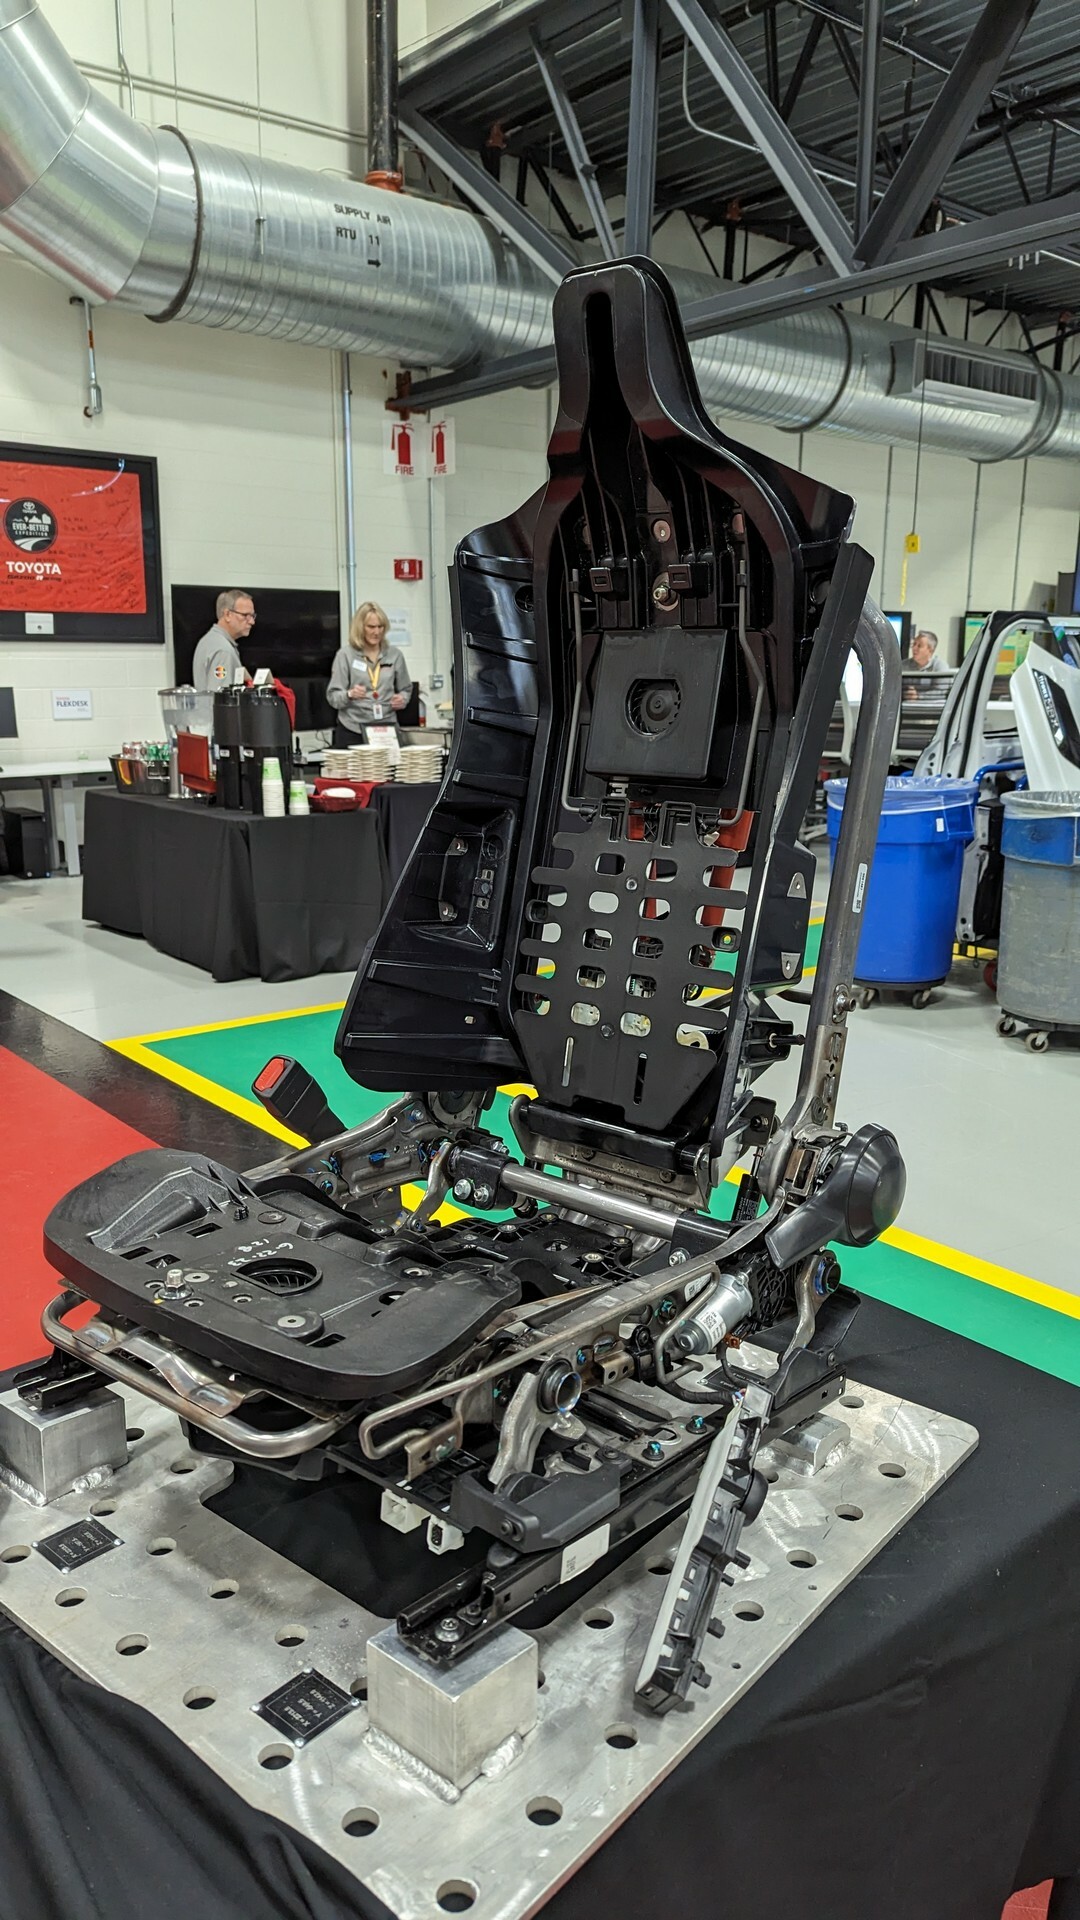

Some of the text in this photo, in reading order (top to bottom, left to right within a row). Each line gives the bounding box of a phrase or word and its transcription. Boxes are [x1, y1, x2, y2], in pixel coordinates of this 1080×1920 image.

[334, 203, 391, 226] SUPPLY AIR
[335, 226, 380, 246] RTU 11
[395, 465, 414, 475] FIRE
[433, 464, 447, 475] FIRE
[12, 522, 50, 532] EVER-BETTER
[5, 561, 62, 575] TOYOTA
